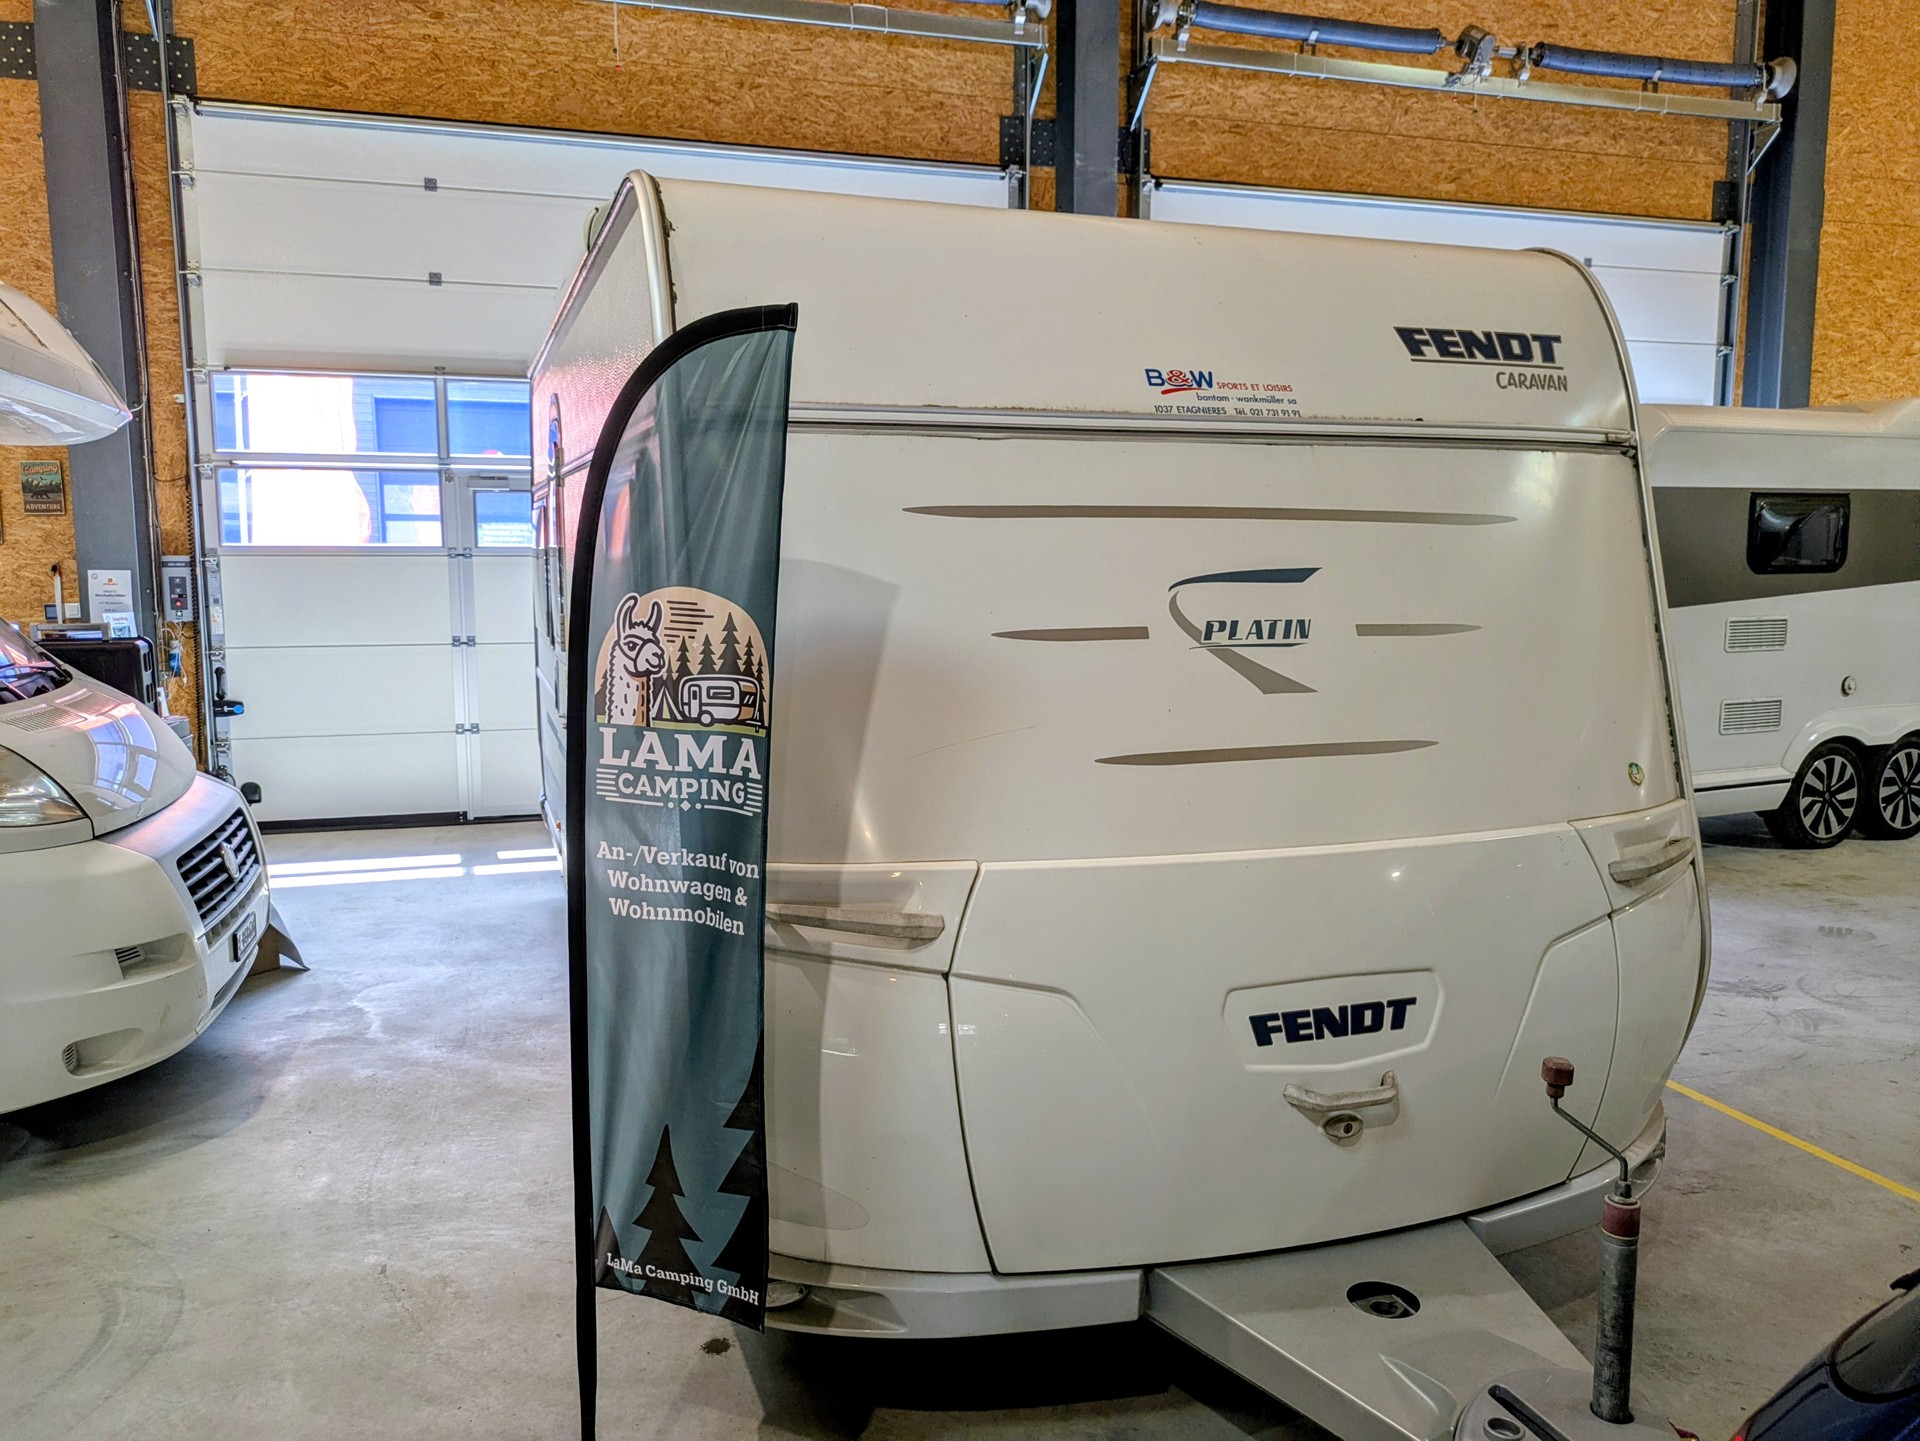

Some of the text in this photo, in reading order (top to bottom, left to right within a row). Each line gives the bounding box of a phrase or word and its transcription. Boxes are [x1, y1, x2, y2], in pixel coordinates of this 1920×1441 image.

[1393, 326, 1562, 364] FENDT
[1144, 368, 1213, 388] B&W
[1216, 382, 1248, 391] SPORTS
[1263, 384, 1293, 392] LOISIRS
[1196, 393, 1230, 402] bantam
[1235, 395, 1284, 404] wankmüller
[1496, 371, 1568, 392] CARAVAN
[1154, 405, 1173, 414] 1037
[1176, 405, 1227, 415] ETAGNIERES
[1250, 408, 1263, 416] 021
[1281, 409, 1290, 417] 91
[1203, 619, 1311, 641] PLATIN
[599, 726, 762, 780] LAMA
[618, 773, 745, 804] CAMPING
[597, 841, 759, 879] An-/Verkauf von
[607, 869, 748, 906] Wohnwagen &
[608, 897, 745, 935] Wohnmobilen
[1249, 996, 1417, 1047] FENDT
[606, 1252, 760, 1306] LaMa Camping GmbH
